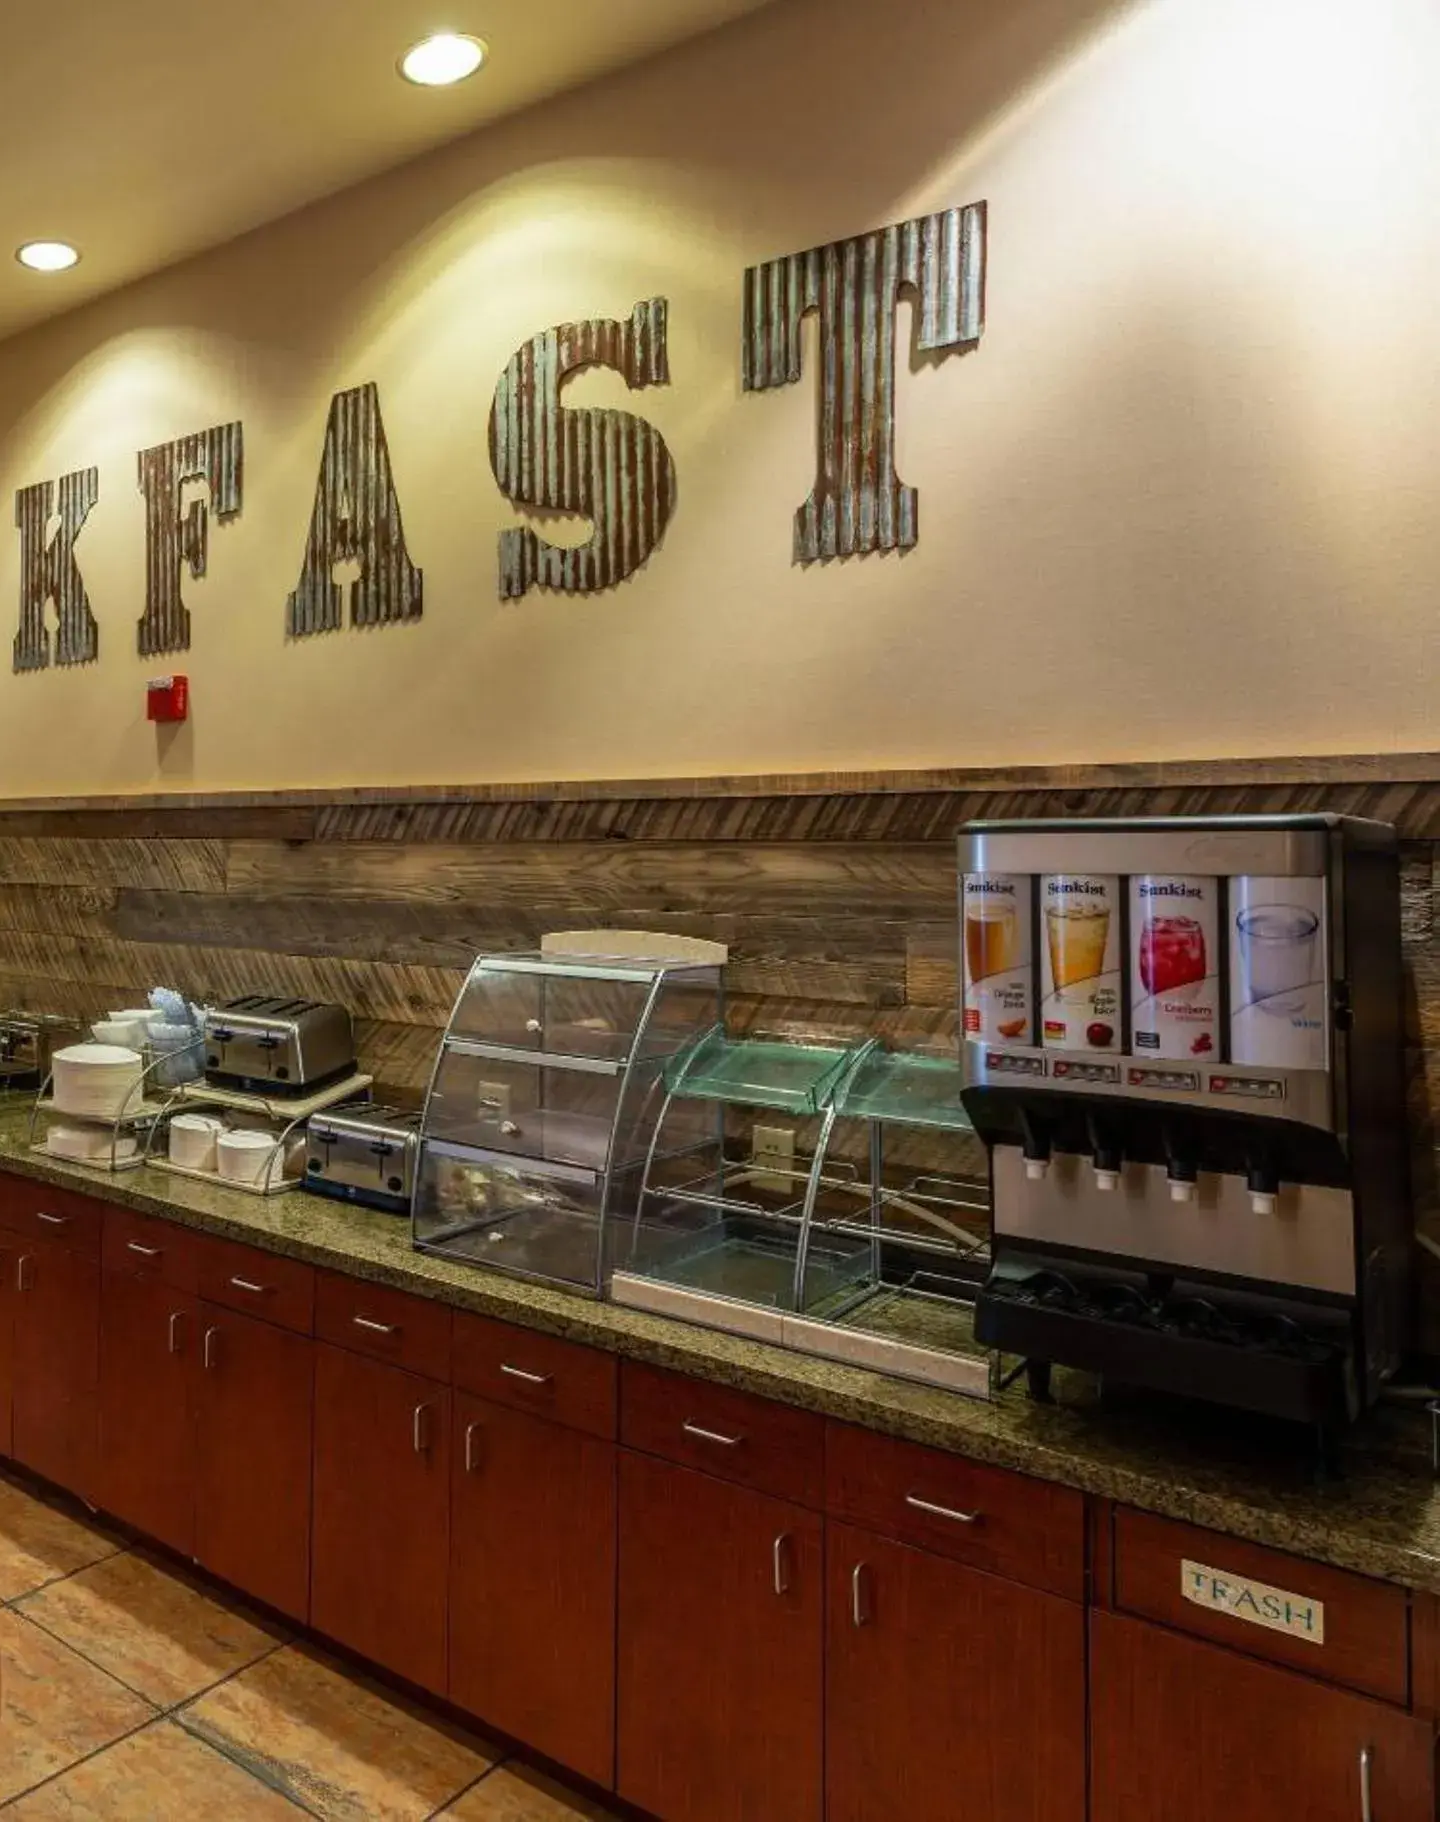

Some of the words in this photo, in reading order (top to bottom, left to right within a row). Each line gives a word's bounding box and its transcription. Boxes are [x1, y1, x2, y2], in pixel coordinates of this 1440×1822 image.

[1047, 881, 1107, 897] Sunkist
[1139, 882, 1203, 899] Sunkist
[1188, 1570, 1313, 1632] TRASH
